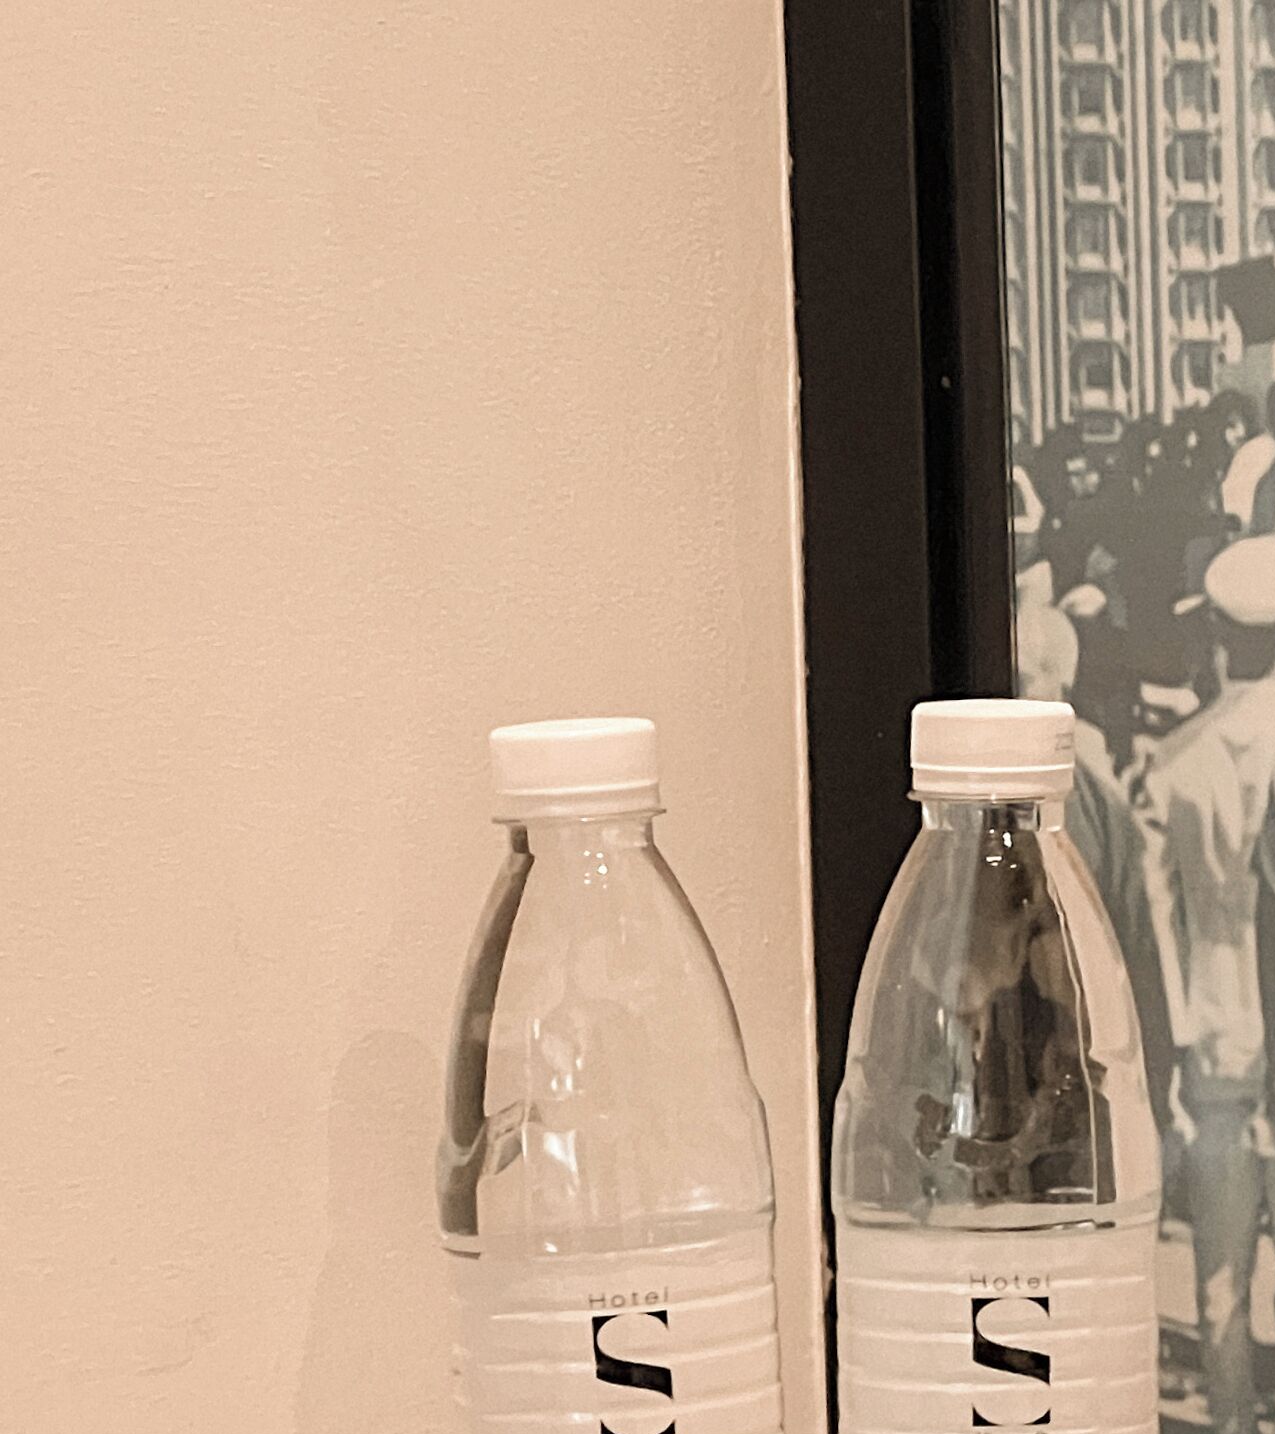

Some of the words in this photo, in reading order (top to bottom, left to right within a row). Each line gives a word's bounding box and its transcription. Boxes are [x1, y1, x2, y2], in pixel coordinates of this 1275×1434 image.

[969, 1272, 1051, 1291] Hotel
[588, 1285, 670, 1310] Hotel
[970, 1296, 1051, 1427] S
